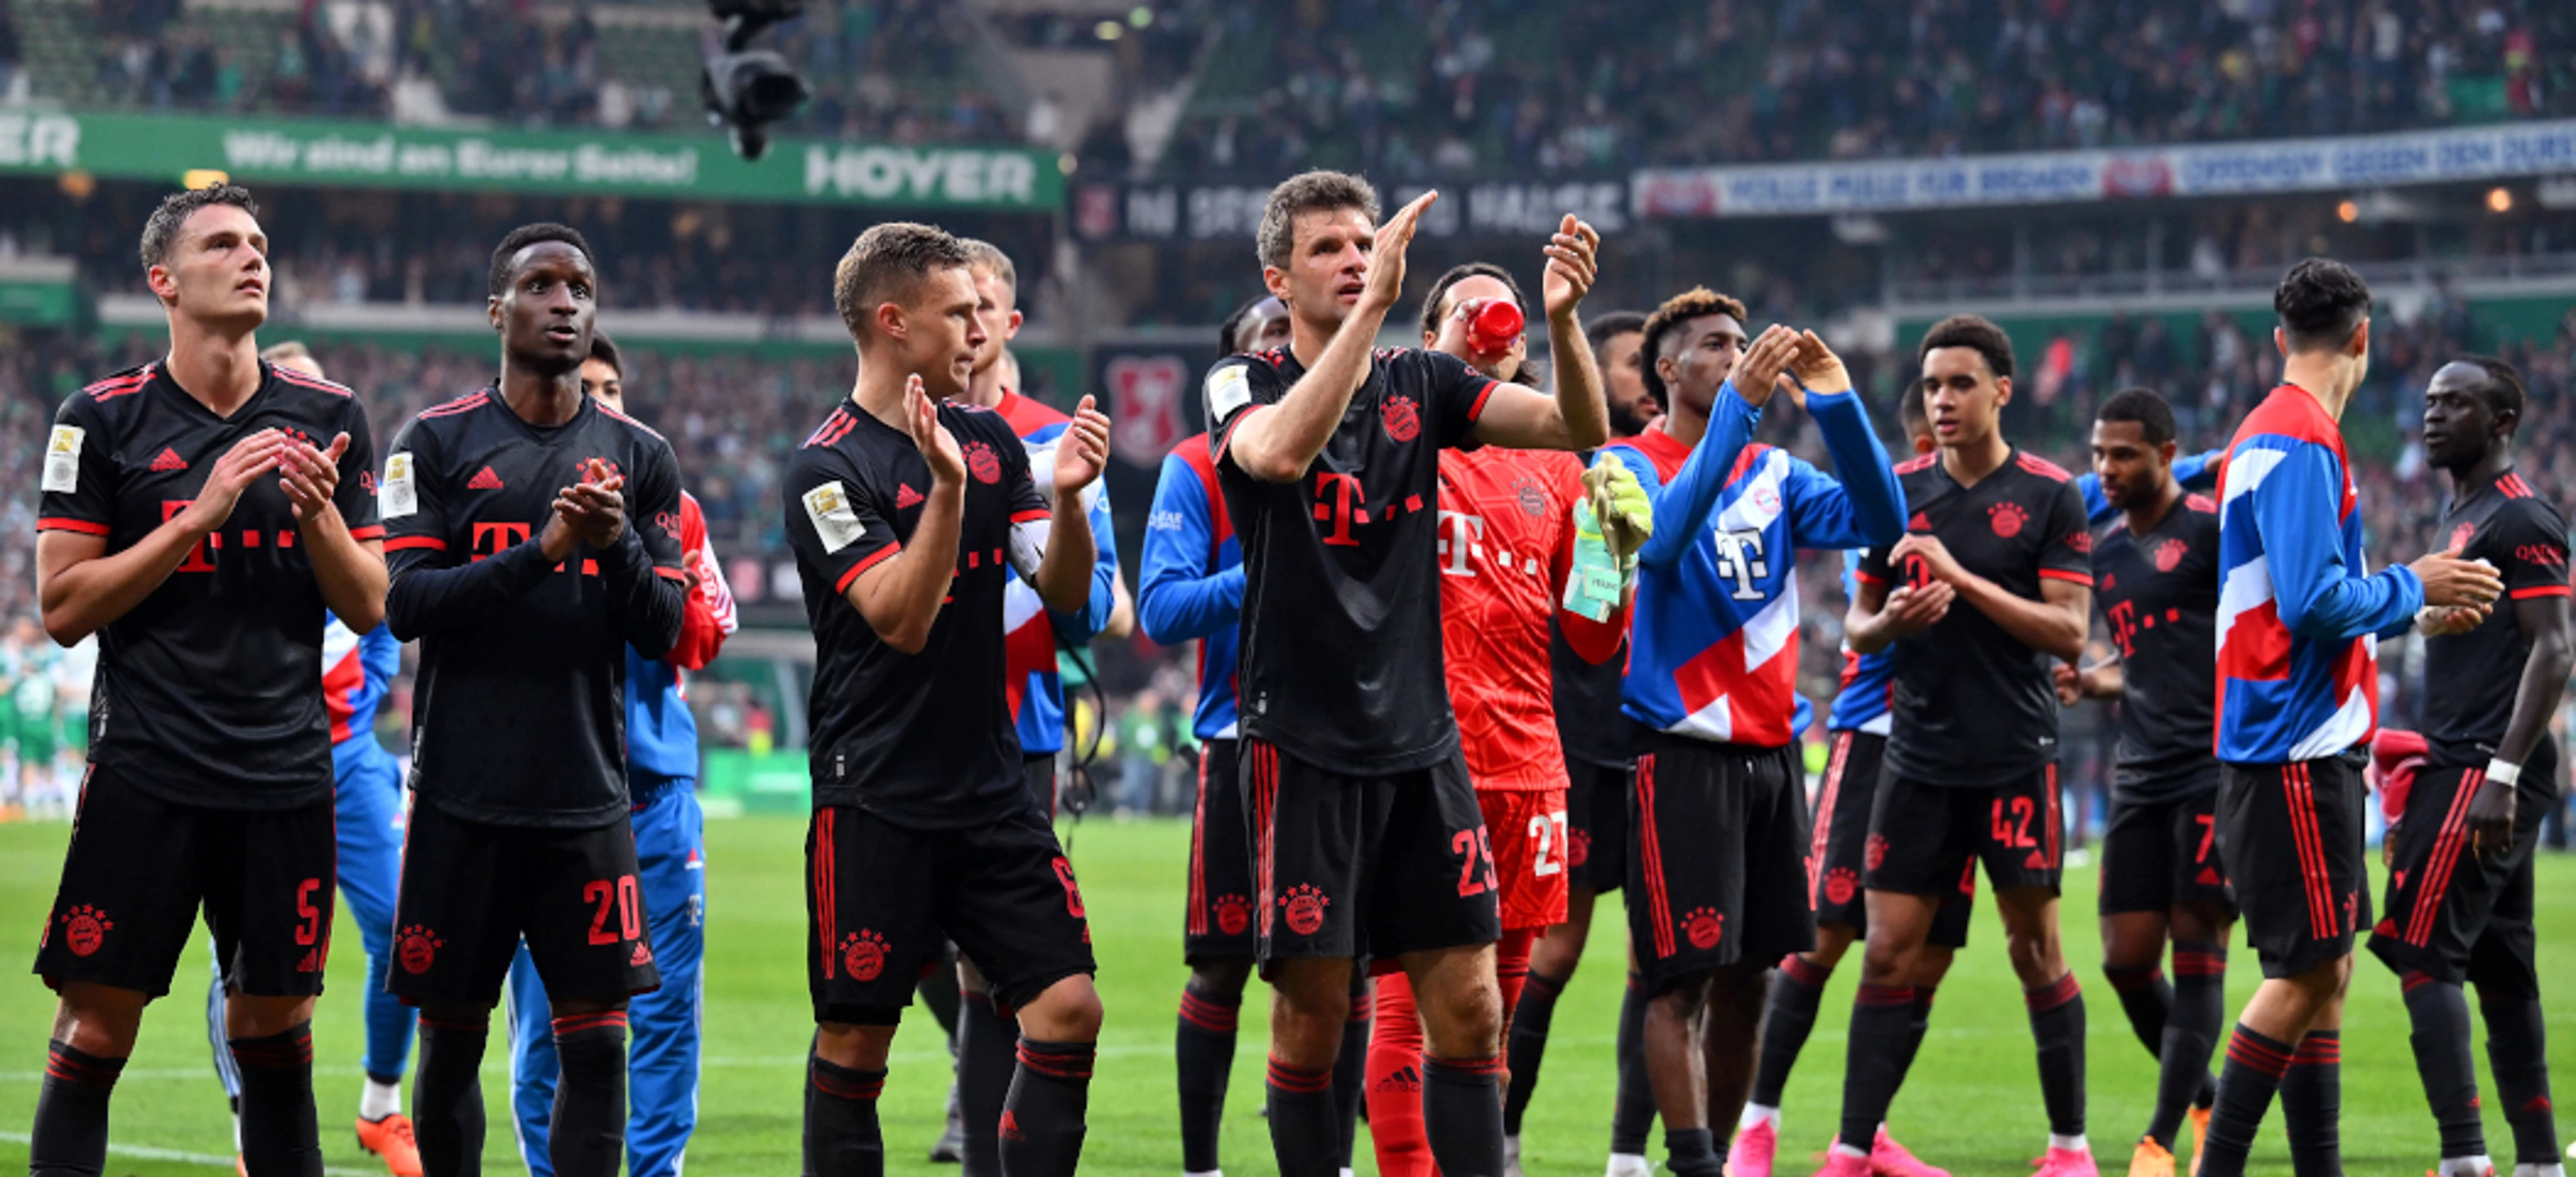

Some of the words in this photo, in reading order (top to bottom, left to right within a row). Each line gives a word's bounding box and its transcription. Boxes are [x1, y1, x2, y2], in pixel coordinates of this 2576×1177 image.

[805, 143, 1038, 201] HOYER
[1313, 471, 1369, 547] T
[1438, 510, 1483, 577] T
[1715, 527, 1769, 600] T
[2108, 599, 2136, 658] T
[1992, 796, 2037, 848] 42
[2195, 814, 2214, 864] 7
[295, 878, 320, 945] 5
[584, 874, 641, 945] 20
